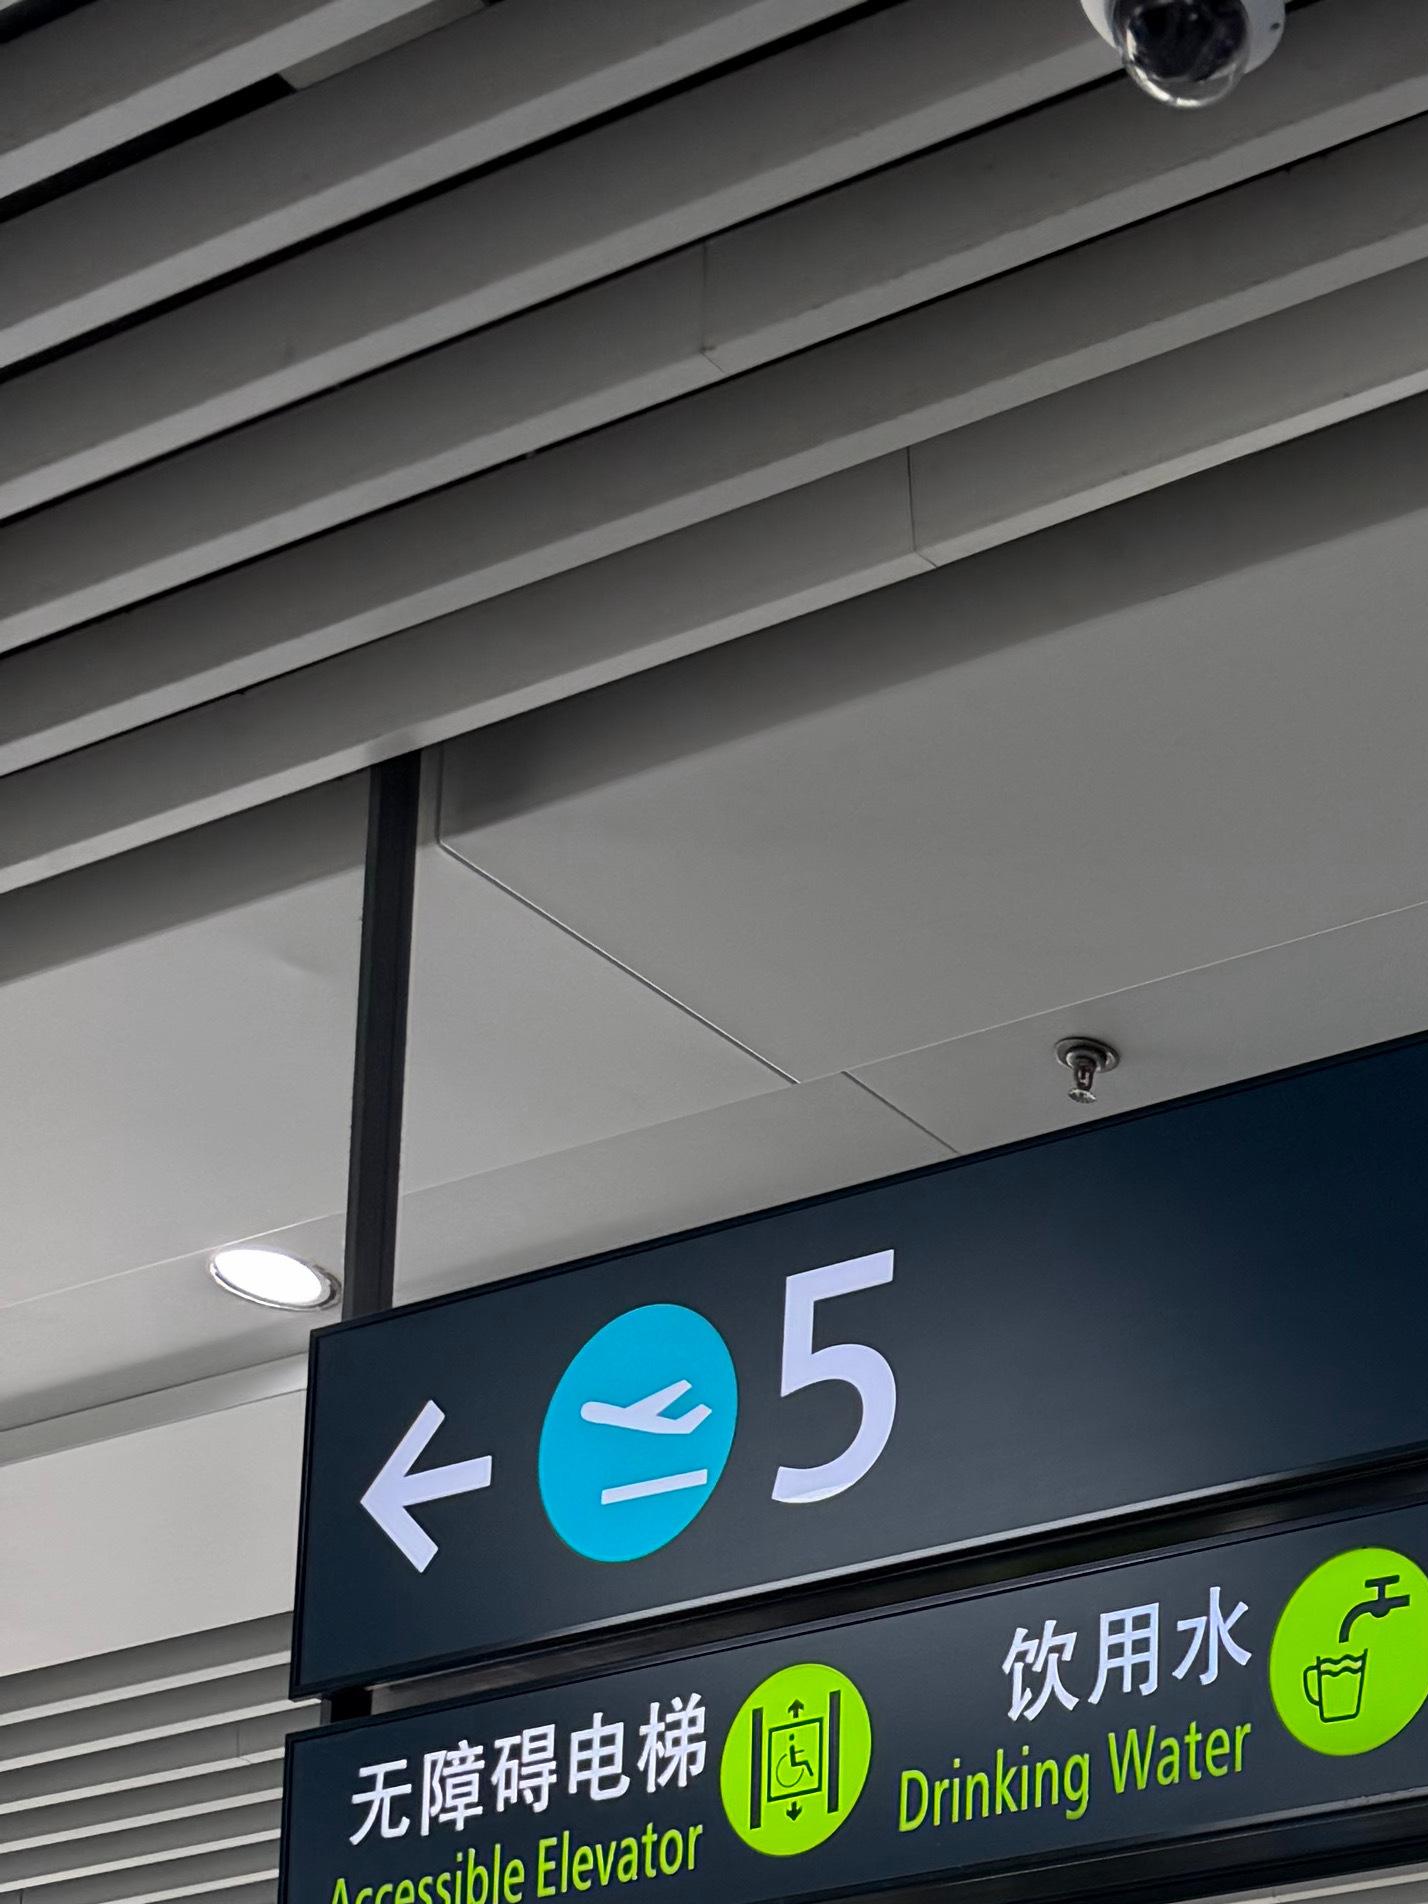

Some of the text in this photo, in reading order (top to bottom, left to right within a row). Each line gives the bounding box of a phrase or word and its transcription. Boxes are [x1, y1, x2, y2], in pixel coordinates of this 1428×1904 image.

[772, 1250, 896, 1503] 5
[1002, 1587, 1252, 1721] 饮用水
[350, 1692, 707, 1845] 无障碍电梯
[899, 1723, 1251, 1831] Drinking Water
[537, 1825, 702, 1897] Elevator
